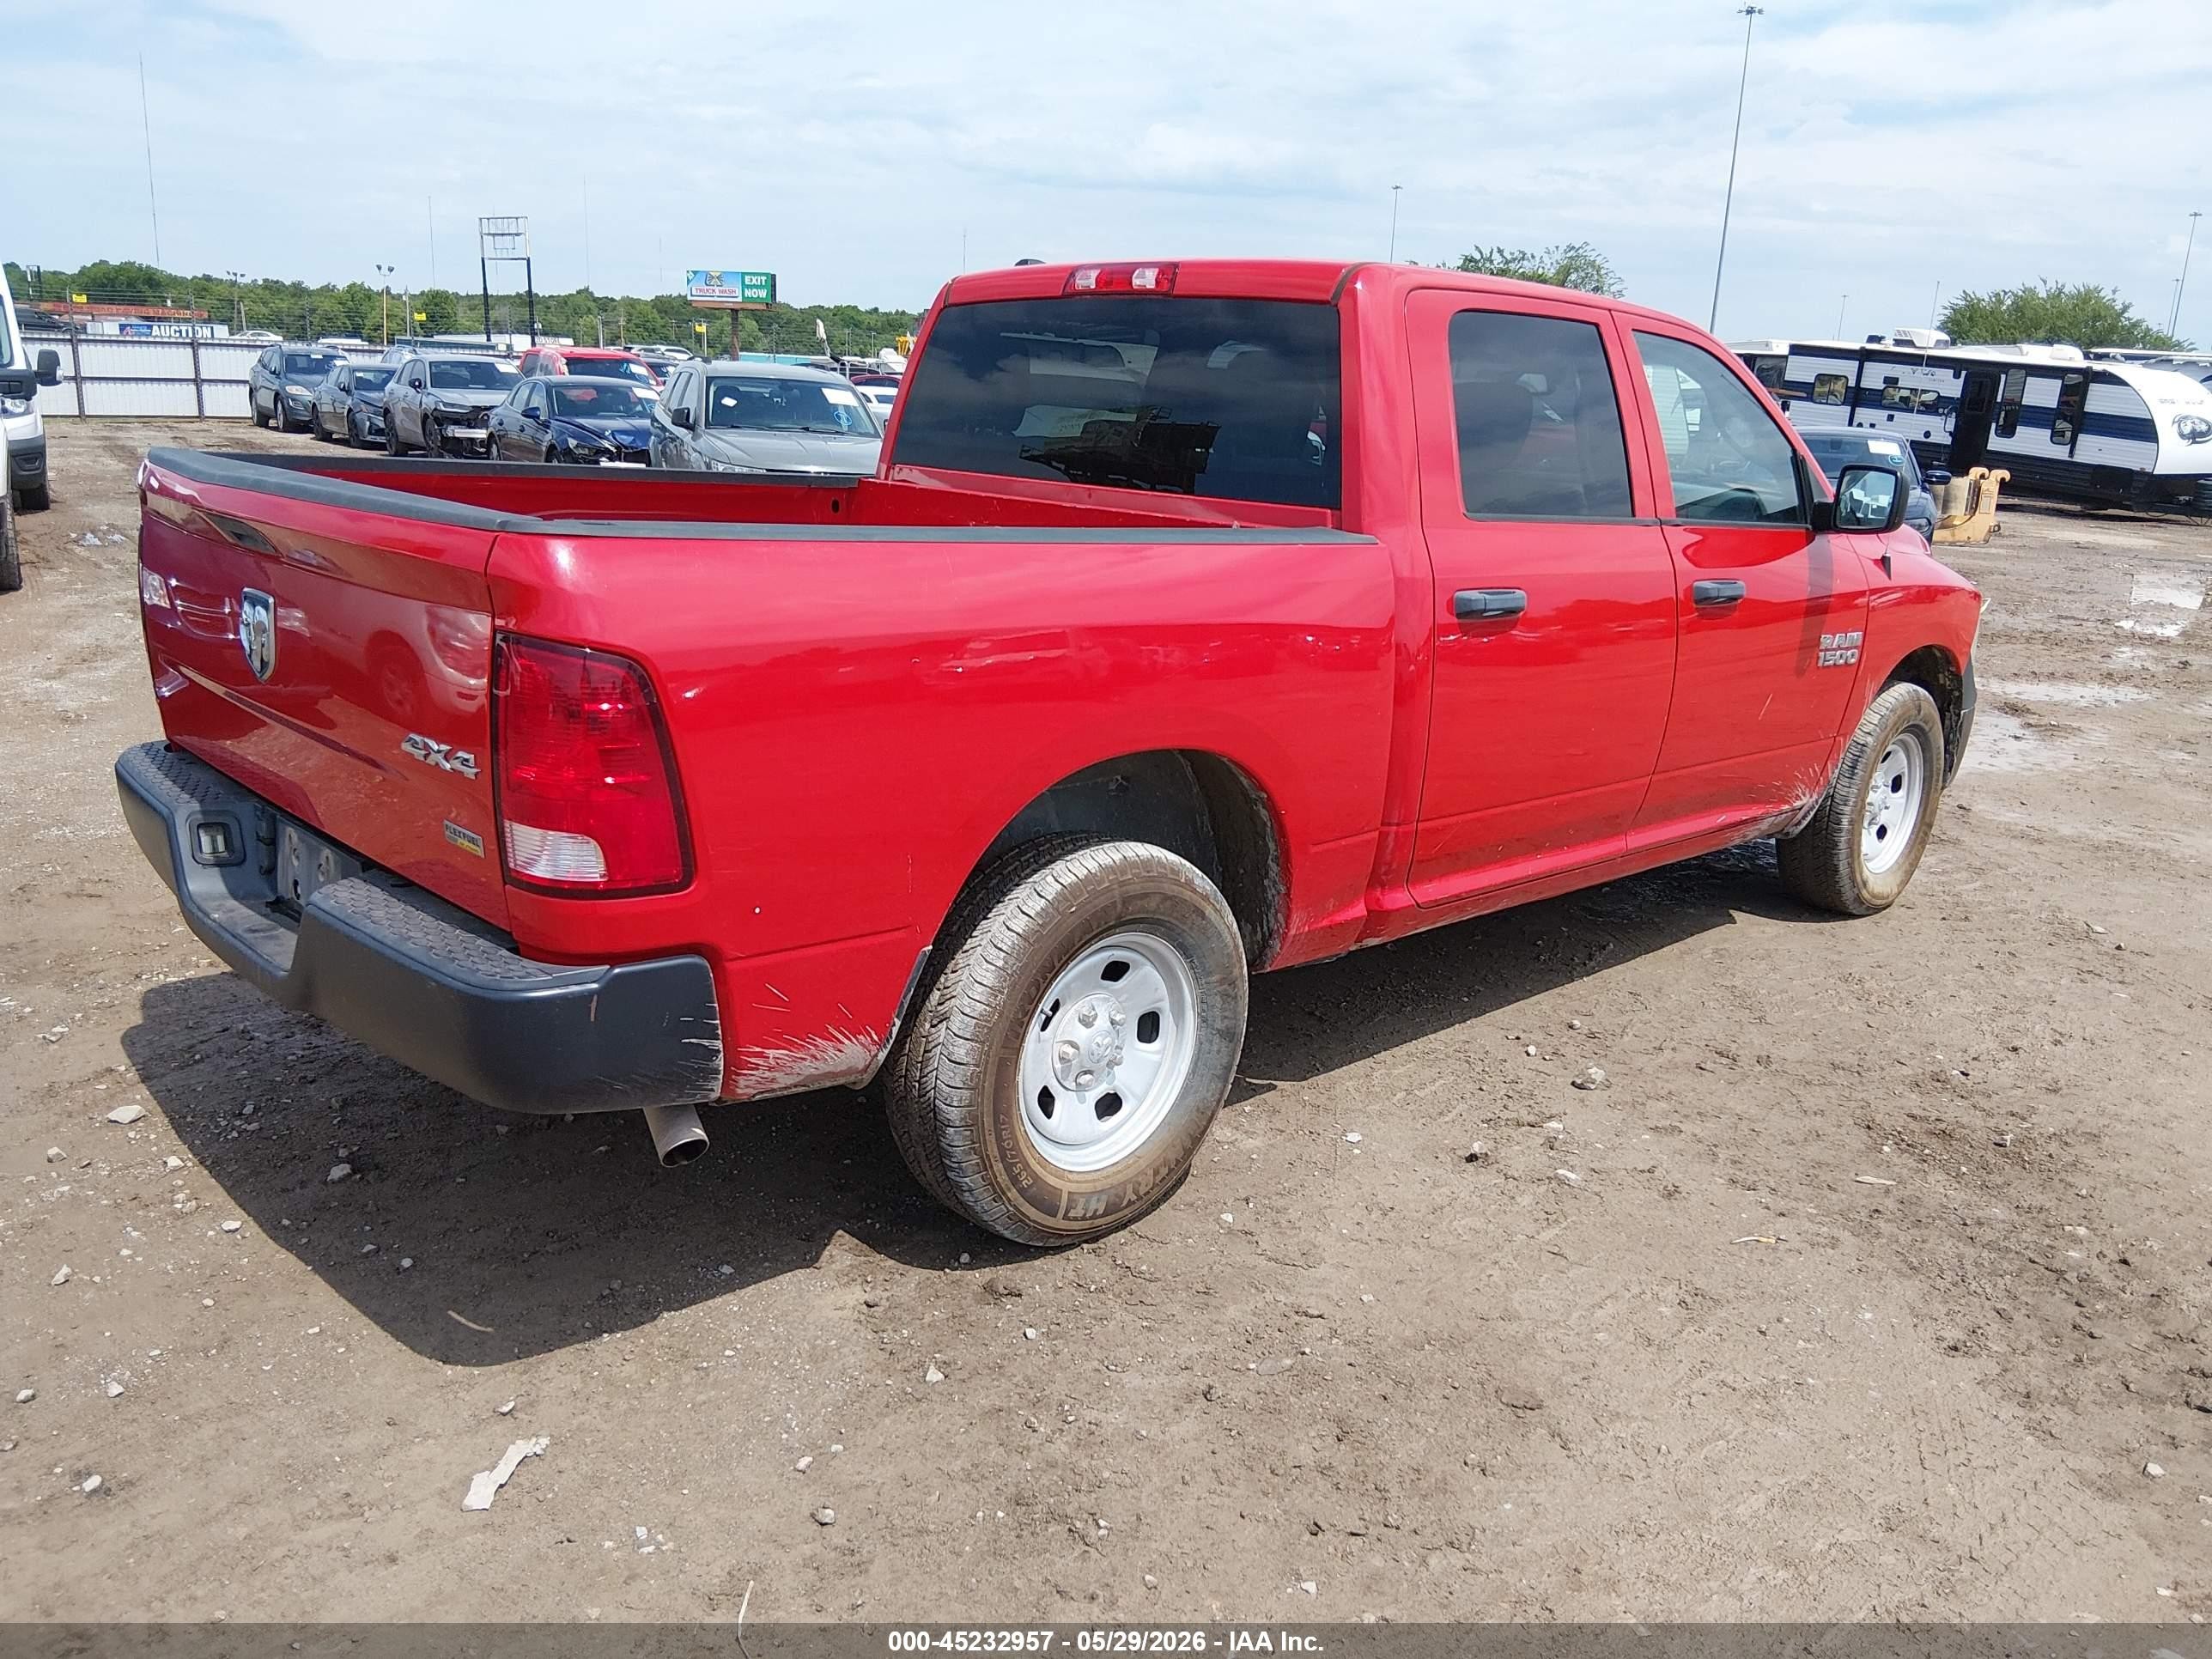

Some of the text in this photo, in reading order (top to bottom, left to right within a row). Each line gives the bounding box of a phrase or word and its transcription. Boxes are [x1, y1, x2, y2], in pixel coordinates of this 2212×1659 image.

[744, 275, 767, 285] EXIT
[744, 288, 767, 298] NOW
[151, 324, 212, 338] AUCTION
[1820, 632, 1863, 649] RAM
[1817, 649, 1859, 666] 1500
